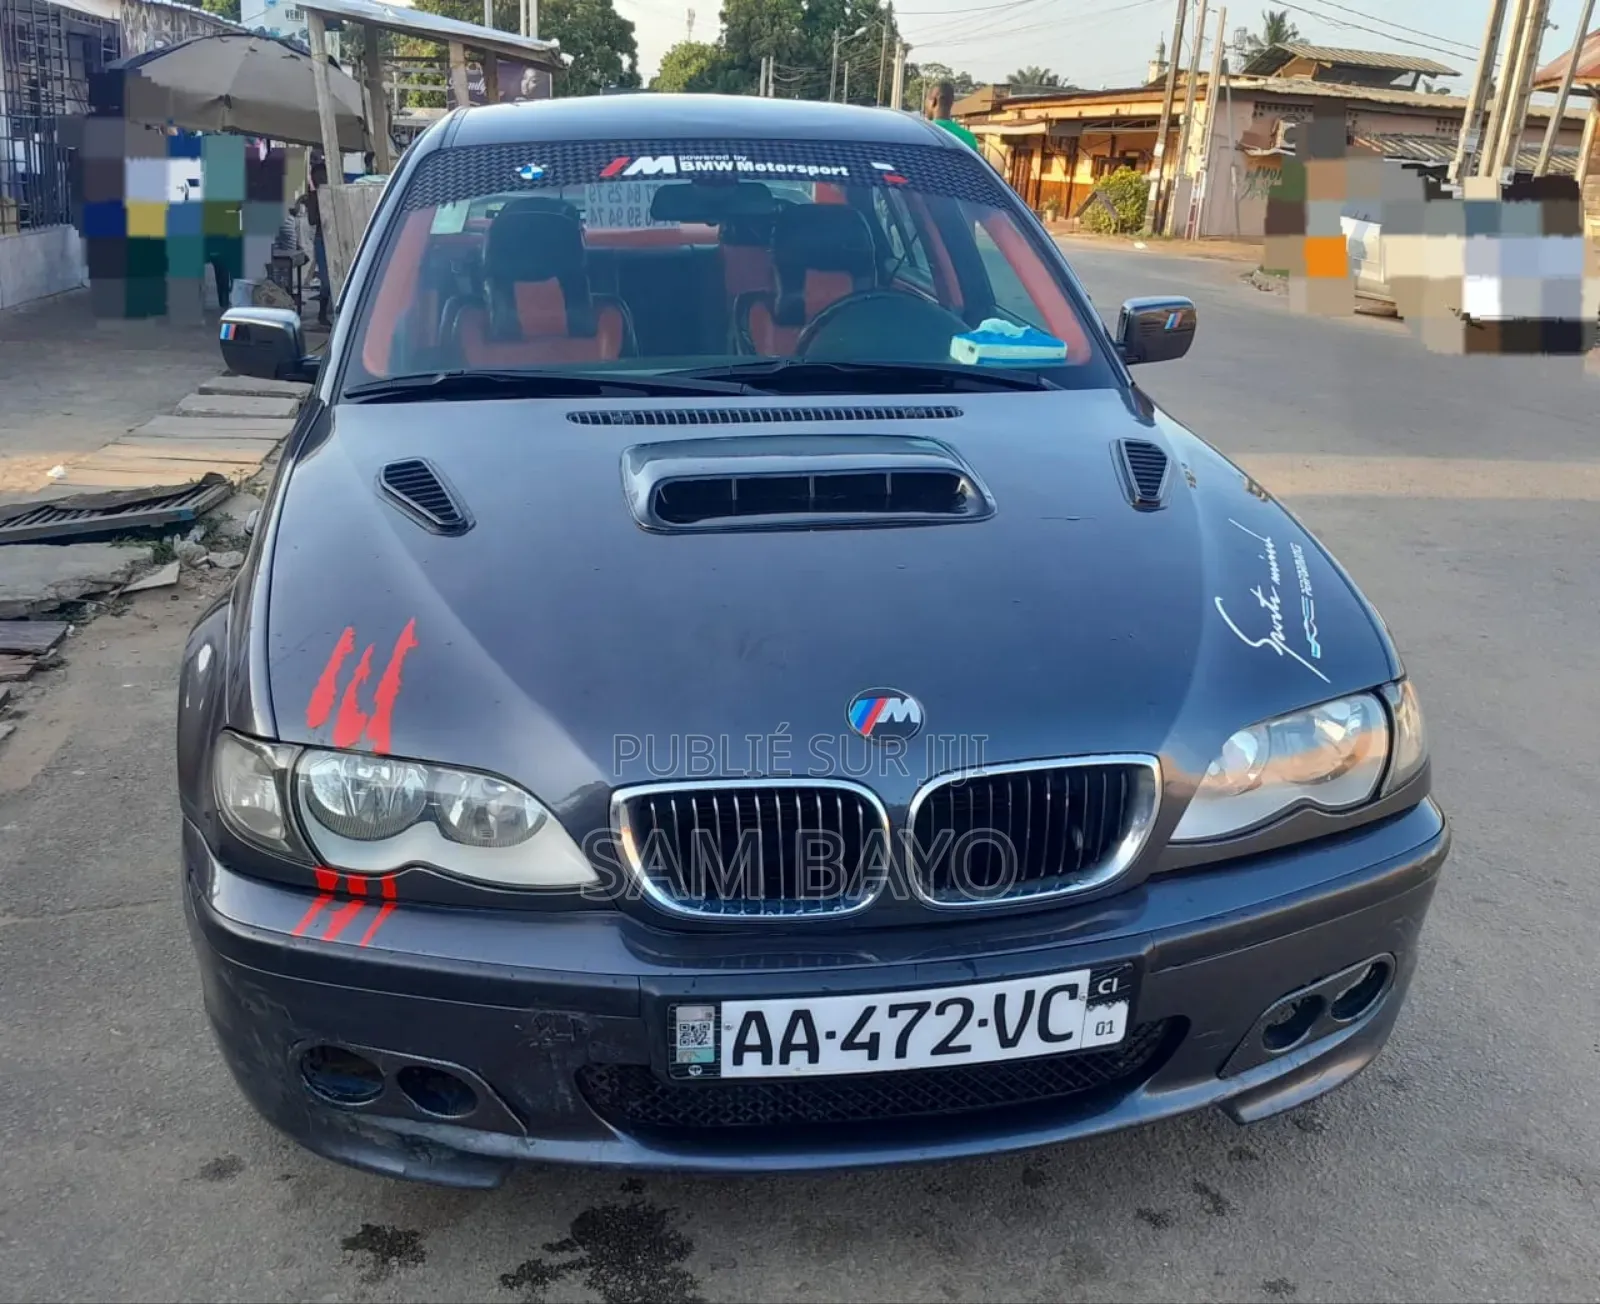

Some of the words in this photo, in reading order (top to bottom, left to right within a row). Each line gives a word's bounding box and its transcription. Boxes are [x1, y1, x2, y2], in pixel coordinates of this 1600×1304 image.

[733, 154, 747, 162] by
[680, 161, 733, 171] BMW
[736, 162, 850, 176] Motorsport
[1098, 977, 1119, 994] CI
[1095, 1019, 1115, 1036] 01
